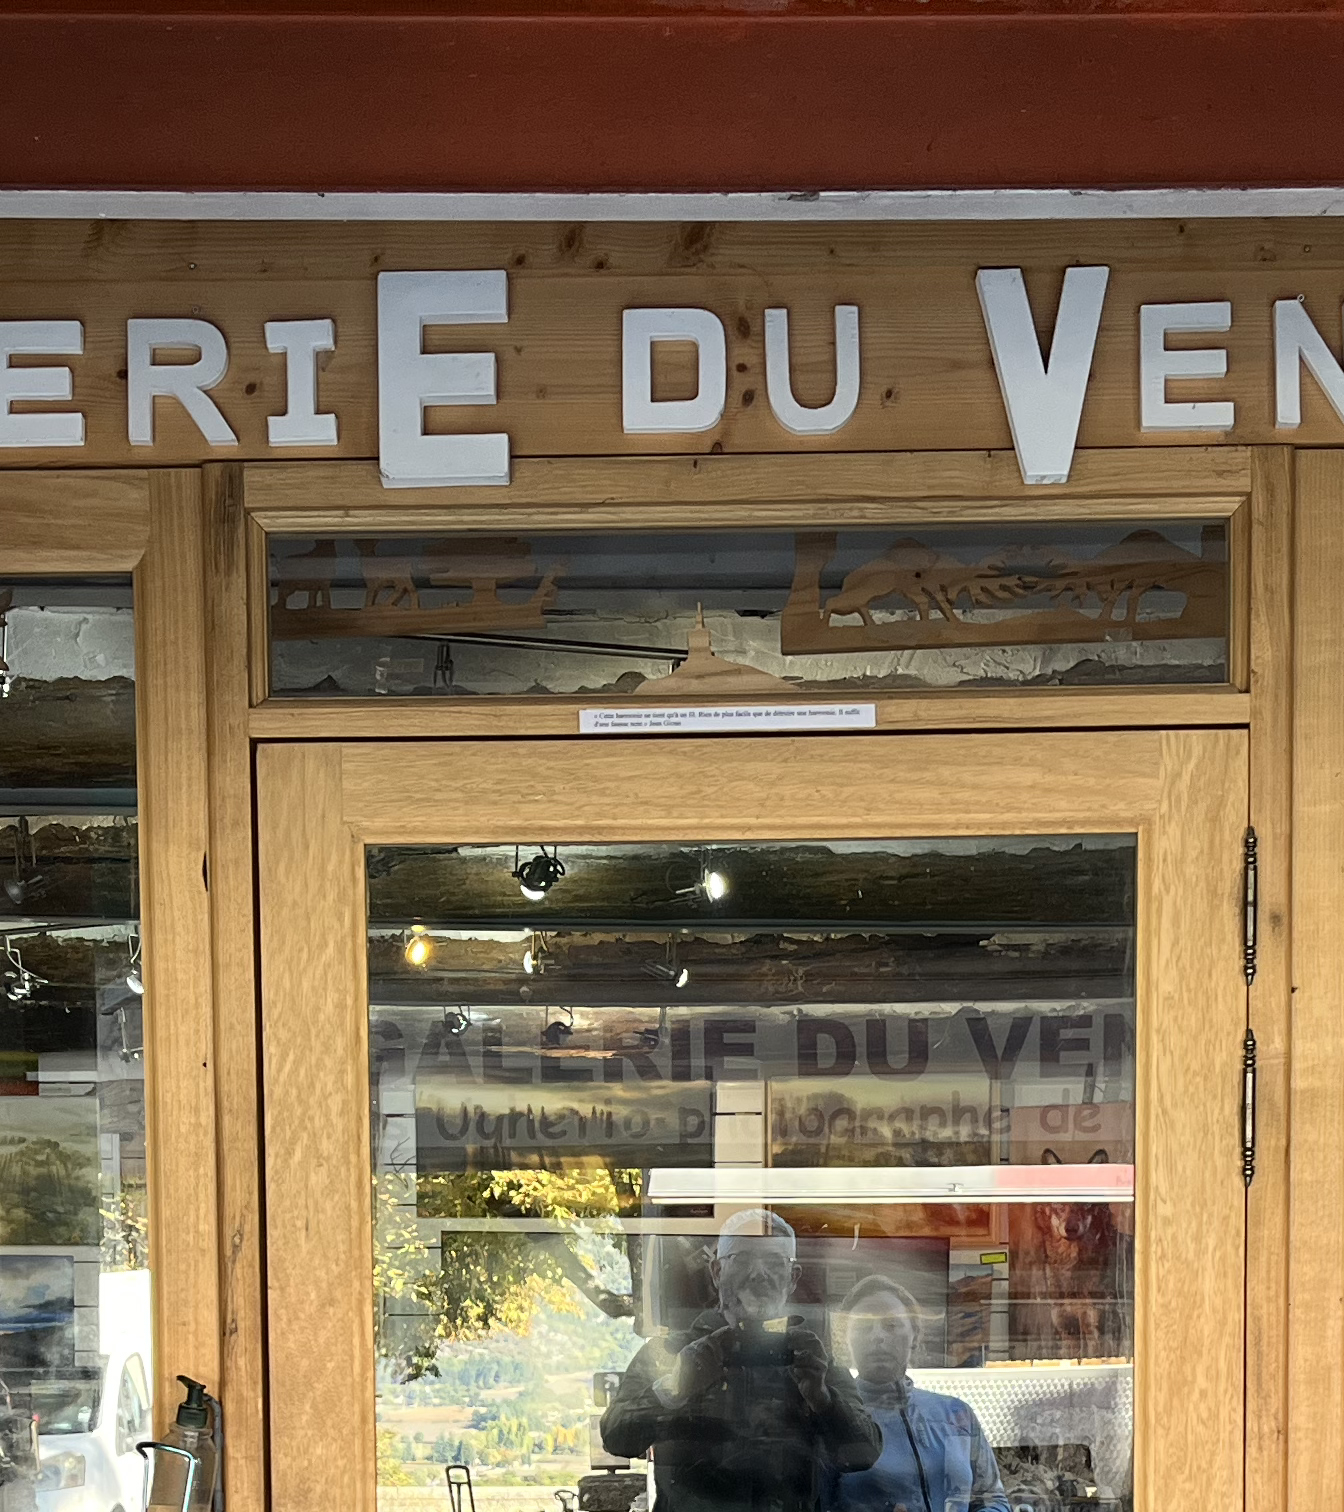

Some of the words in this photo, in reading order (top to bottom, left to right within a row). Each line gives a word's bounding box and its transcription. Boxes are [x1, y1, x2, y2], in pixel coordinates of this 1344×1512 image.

[622, 303, 861, 436] DU
[722, 711, 734, 719] plus
[797, 1016, 929, 1081] DU
[1039, 1088, 1103, 1134] de
